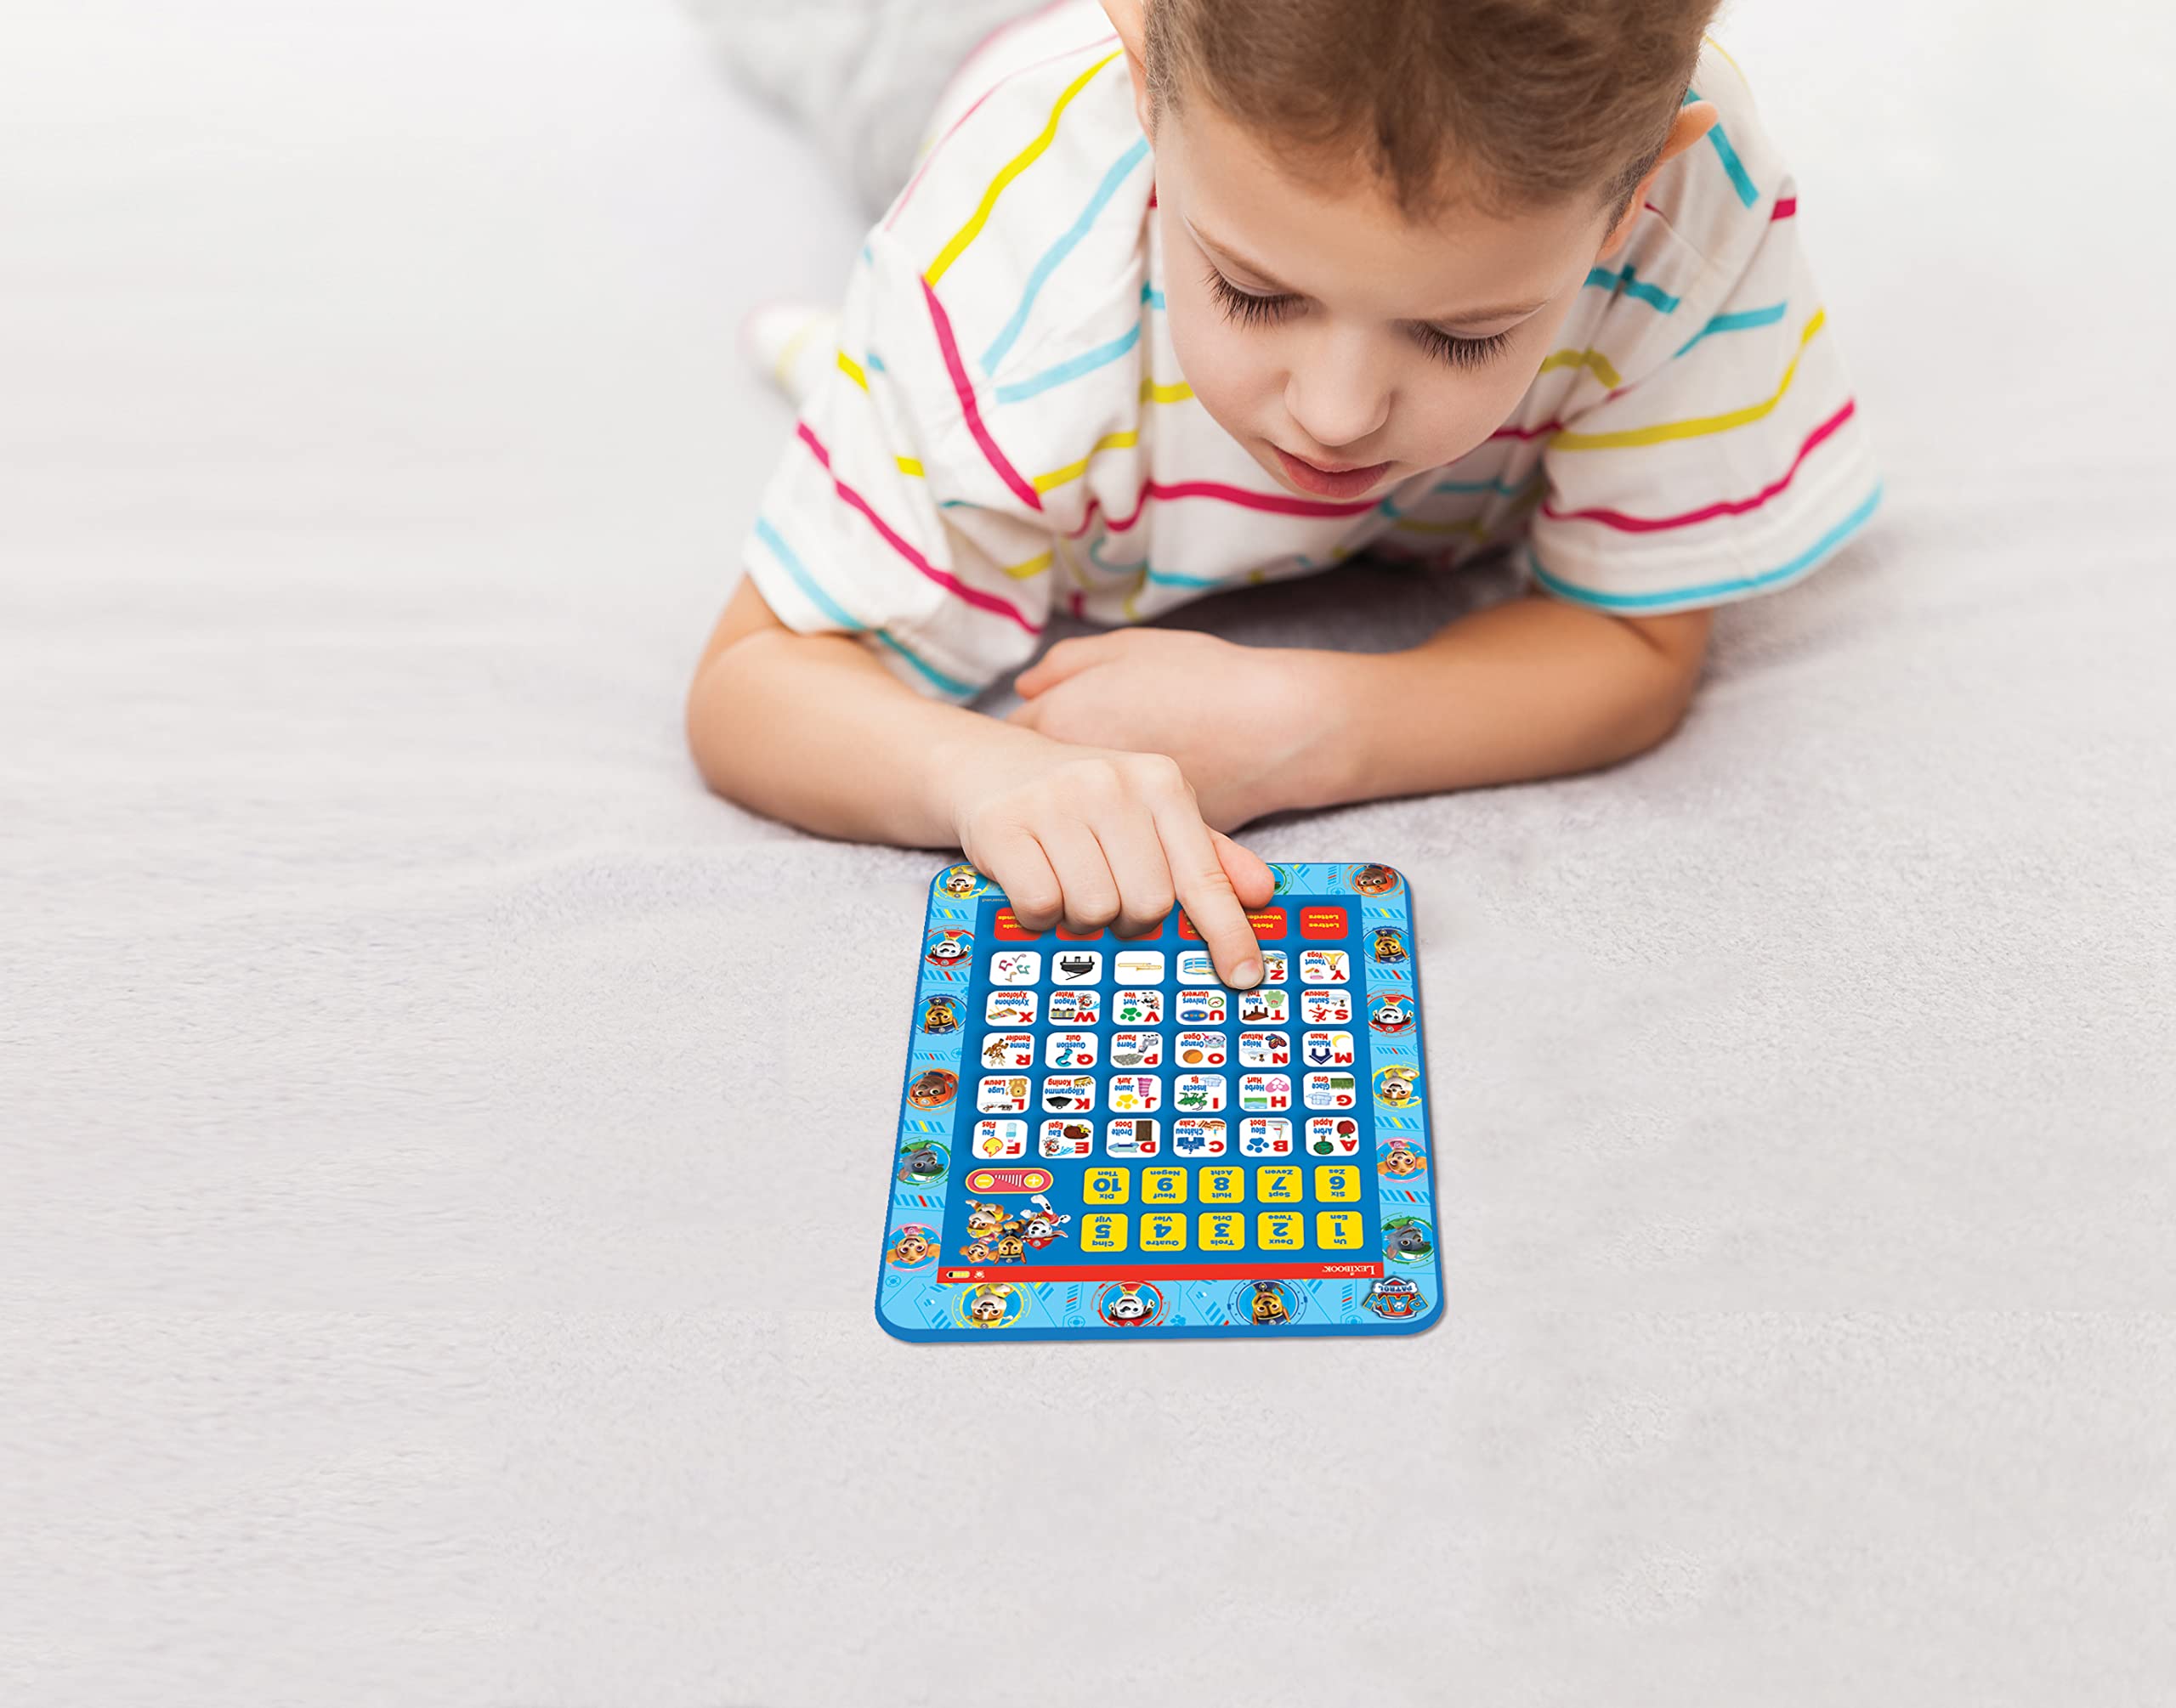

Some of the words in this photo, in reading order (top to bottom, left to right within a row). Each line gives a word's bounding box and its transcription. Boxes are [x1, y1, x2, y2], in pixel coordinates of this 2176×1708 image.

[1270, 970, 1284, 980] Z
[1331, 970, 1346, 980] Y
[1018, 1012, 1034, 1022] X
[1074, 1012, 1096, 1022] W
[1144, 1012, 1160, 1021] V
[1210, 1010, 1224, 1021] U
[1271, 1010, 1284, 1020] T
[1334, 1010, 1348, 1020] S
[1016, 1055, 1031, 1065] R
[1077, 1054, 1093, 1065] Q
[1144, 1054, 1158, 1064] P
[1208, 1054, 1224, 1064] O
[1272, 1053, 1288, 1064] N
[1334, 1053, 1352, 1063] M
[1045, 1087, 1085, 1095] Kilogramme
[1012, 1099, 1024, 1110] L
[1074, 1099, 1090, 1110] K
[1145, 1097, 1157, 1108] J
[1213, 1098, 1218, 1109] I
[1271, 1096, 1286, 1107] H
[1336, 1095, 1352, 1106] G
[1313, 1118, 1333, 1127] Appel
[1006, 1143, 1020, 1154] F
[1074, 1142, 1089, 1153] E
[1140, 1141, 1156, 1152] D
[1209, 1140, 1224, 1152] C
[1273, 1140, 1288, 1151] B
[1340, 1140, 1357, 1151] A
[1093, 1179, 1122, 1191] 10
[1157, 1178, 1173, 1191] 9
[1214, 1177, 1230, 1191] 8
[1272, 1177, 1287, 1190] 7
[1329, 1176, 1346, 1190] 6
[1095, 1224, 1111, 1238] 5
[1153, 1224, 1172, 1237] 4
[1214, 1224, 1230, 1237] 3
[1272, 1223, 1289, 1236] 2
[1334, 1223, 1346, 1236] 1
[1363, 1292, 1429, 1312] PAW
